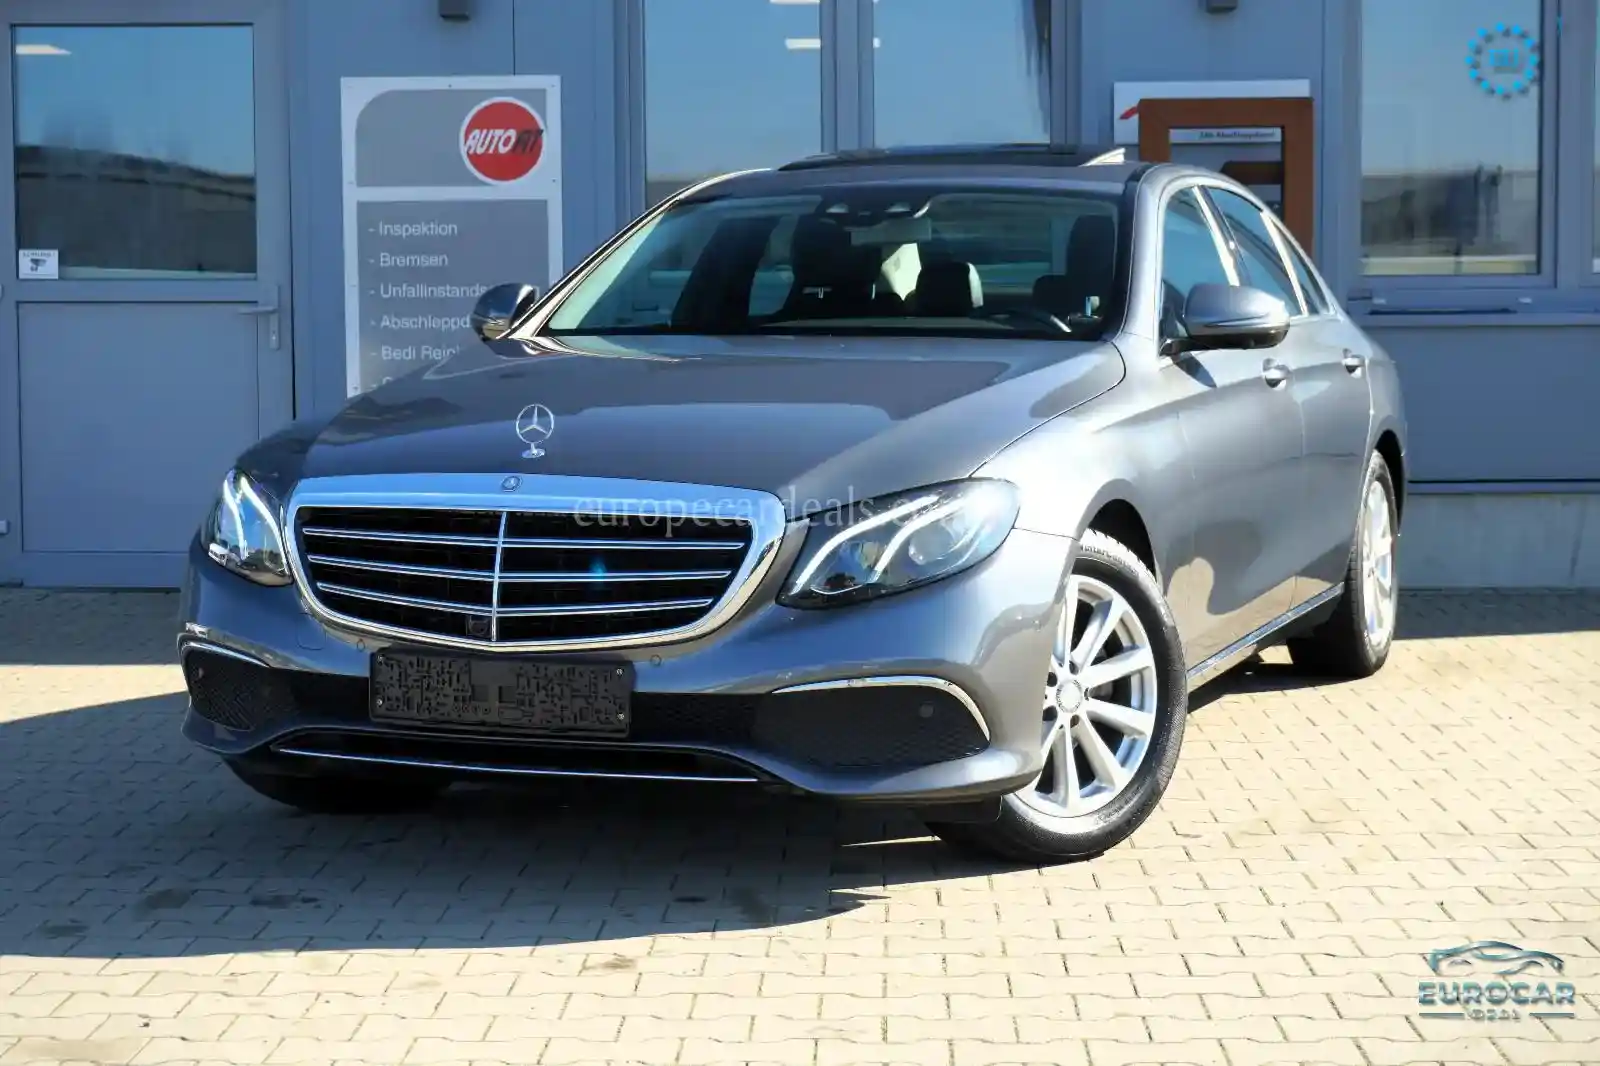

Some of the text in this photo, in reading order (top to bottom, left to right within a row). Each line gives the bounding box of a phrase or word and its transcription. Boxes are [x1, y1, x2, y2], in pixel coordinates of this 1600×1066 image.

[379, 220, 458, 239] Inspektion
[380, 252, 449, 267] Bremsen
[380, 314, 471, 333] Abschleppd
